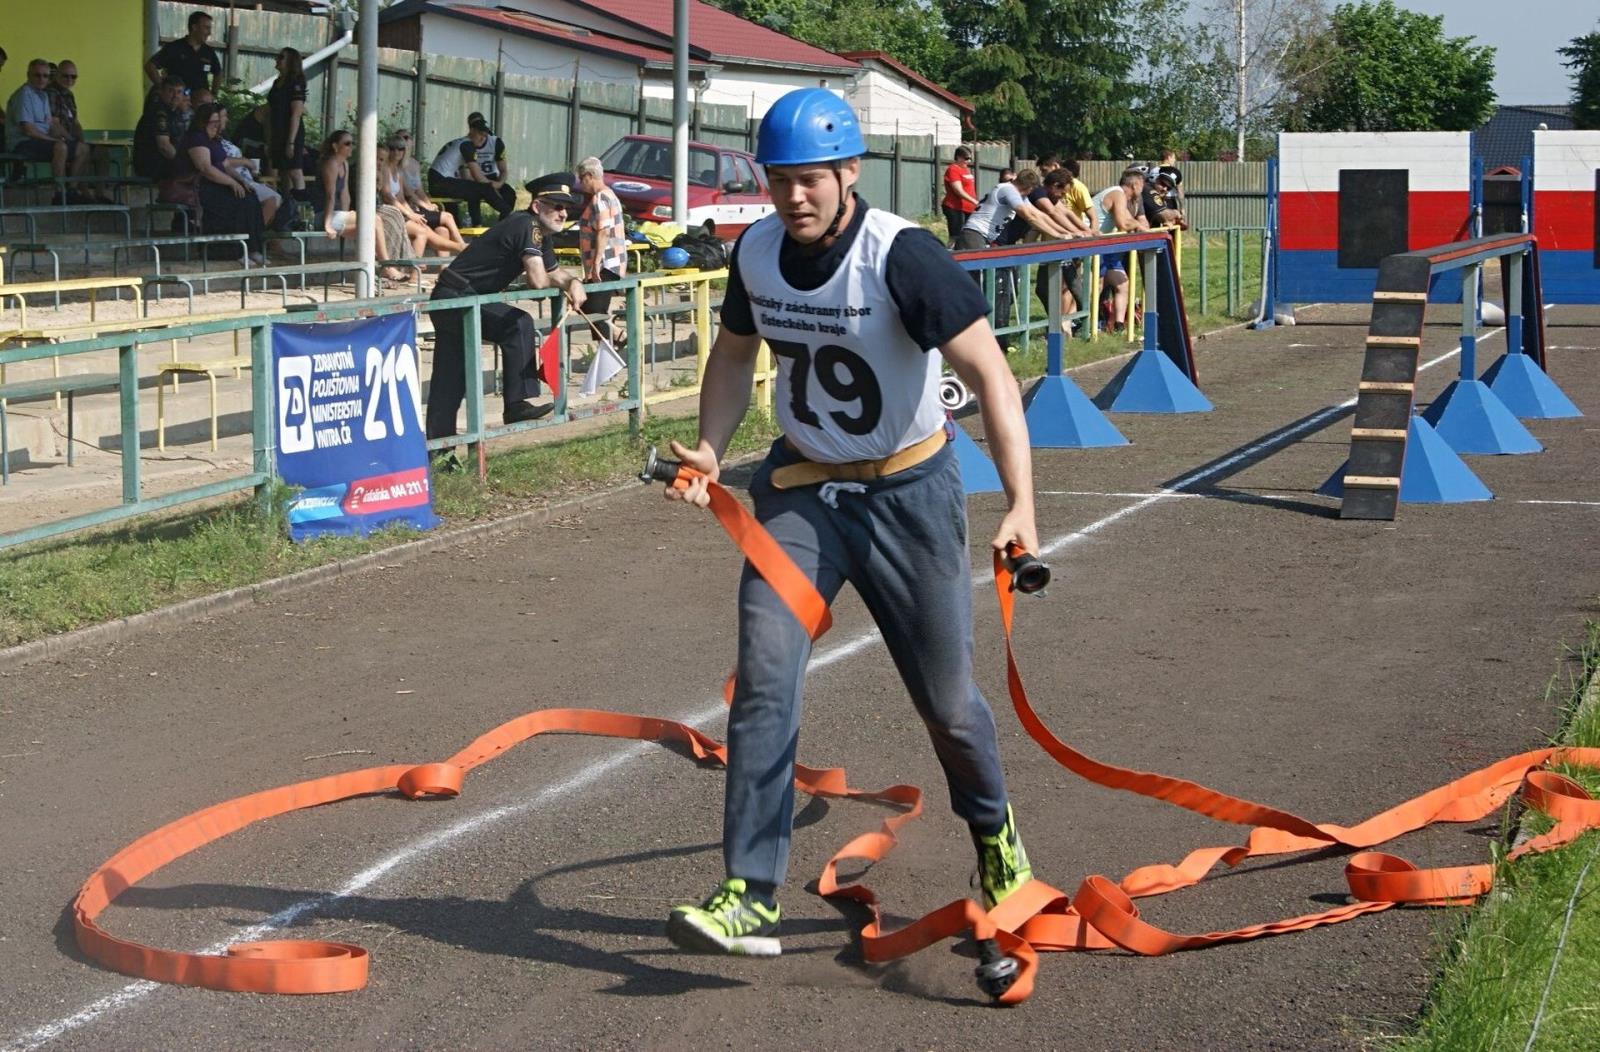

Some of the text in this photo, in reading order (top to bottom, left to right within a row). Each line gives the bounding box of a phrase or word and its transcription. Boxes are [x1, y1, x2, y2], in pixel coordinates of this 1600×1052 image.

[785, 301, 841, 319] záchranný
[844, 305, 872, 317] sbor
[818, 321, 847, 337] kraje
[312, 344, 355, 373] ZDRAVOTNÍ
[364, 343, 424, 441] 211
[764, 337, 882, 436] 79
[311, 398, 362, 424] MINISTERSTVA
[315, 420, 353, 449] VNITRA ČR
